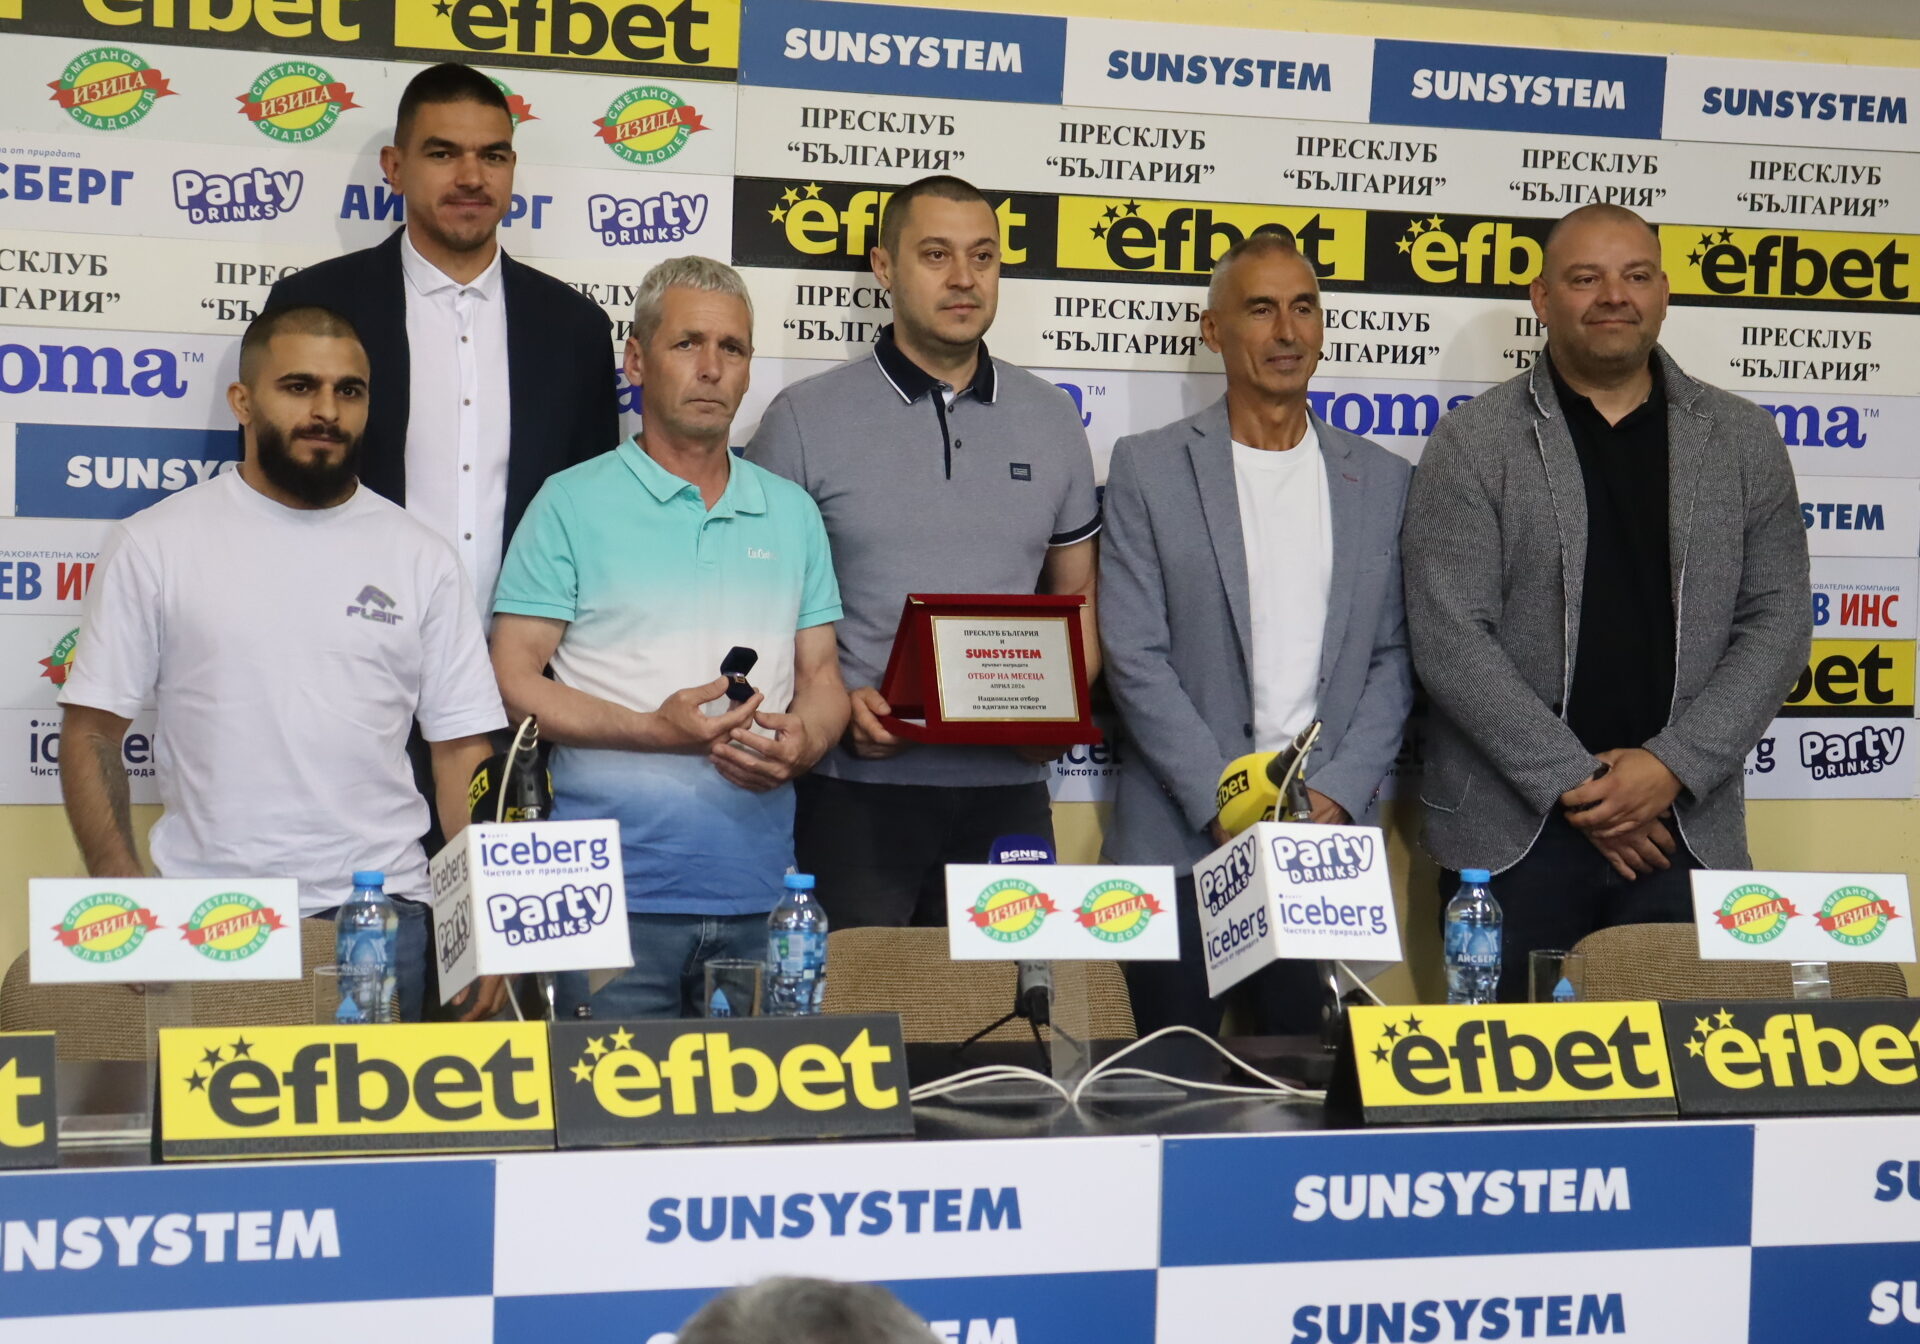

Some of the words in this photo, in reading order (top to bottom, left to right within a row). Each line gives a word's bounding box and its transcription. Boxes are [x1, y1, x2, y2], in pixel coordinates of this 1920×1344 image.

[450, 0, 710, 64] efbet
[64, 49, 141, 82] СМЕТАНОВ
[783, 27, 1023, 74] SUNSYSTEM
[252, 63, 328, 96] СМЕТАНОВ
[1106, 50, 1332, 92] SUNSYSTEM
[72, 71, 147, 106] ИЗИДА
[260, 85, 332, 118] ИЗИДА
[607, 87, 679, 120] СМЕТАНОВ
[1411, 69, 1626, 110] SUNSYSTEM
[1702, 86, 1907, 124] SUNSYSTEM
[71, 89, 154, 130] СЛАДОЛЕД
[258, 102, 340, 142] СЛАДОЛЕД
[615, 107, 684, 143] ИЗИДА
[801, 107, 955, 137] ПРЕСКЛУБ
[613, 125, 691, 165] СЛАДОЛЕД
[1059, 122, 1206, 151] ПРЕСКЛУБ
[1296, 136, 1438, 164] ПРЕСКЛУБ
[787, 141, 965, 171] “БЪЛГАРИЯ”
[1045, 156, 1215, 184] “БЪЛГАРИЯ”
[1522, 148, 1658, 176] ПРЕСКЛУБ
[173, 168, 303, 211] Party
[1283, 170, 1447, 196] “БЪЛГАРИЯ”
[1749, 160, 1881, 186] ПРЕСКЛУБ
[1510, 182, 1666, 207] “БЪЛГАРИЯ”
[1737, 192, 1889, 217] “БЪЛГАРИЯ”
[189, 204, 278, 224] DRINKS
[588, 191, 708, 234] Party
[602, 226, 685, 247] DRINKS
[1106, 208, 1335, 278] efbt
[1700, 235, 1909, 300] efbet
[1053, 296, 1200, 325] ПРЕСКЛУБ
[1741, 326, 1871, 350] ПРЕСКЛУБ
[1730, 357, 1880, 382] “БЪЛГАРИЯ”
[1840, 593, 1899, 627] ИНС
[965, 649, 1042, 659] SUNSYSTEM
[967, 673, 995, 681] ОТБОР
[997, 673, 1010, 681] НА
[1011, 673, 1045, 681] МЕСЕЦА
[1800, 726, 1904, 767] Party
[1057, 767, 1099, 777] Чистота
[1812, 759, 1883, 780] DRINKS
[480, 832, 610, 870] iceberg
[1000, 849, 1048, 860] BGNES
[1272, 833, 1374, 872] Party
[1200, 835, 1256, 908] Party
[1289, 864, 1359, 884] DRINKS
[487, 884, 612, 933] Party
[987, 895, 1042, 927] ИЗИДА
[1094, 895, 1148, 927] ИЗИДА
[1280, 896, 1387, 934] iceberg
[1733, 900, 1784, 929] ИЗИДА
[1833, 901, 1883, 931] ИЗИДА
[77, 910, 142, 943] ИЗИДА
[203, 910, 268, 942] ИЗИДА
[506, 918, 591, 946] DRINKS
[1206, 904, 1268, 961] iceberg
[1391, 1015, 1661, 1096] efbet
[208, 1038, 541, 1127] efbet
[592, 1028, 898, 1118] efbet
[1292, 1166, 1631, 1221] SUNSYSTEM
[646, 1187, 1022, 1245] SUNSYSTEM
[0, 1207, 341, 1272] NSYSTEM
[1290, 1293, 1626, 1344] SUNSYSTEM
